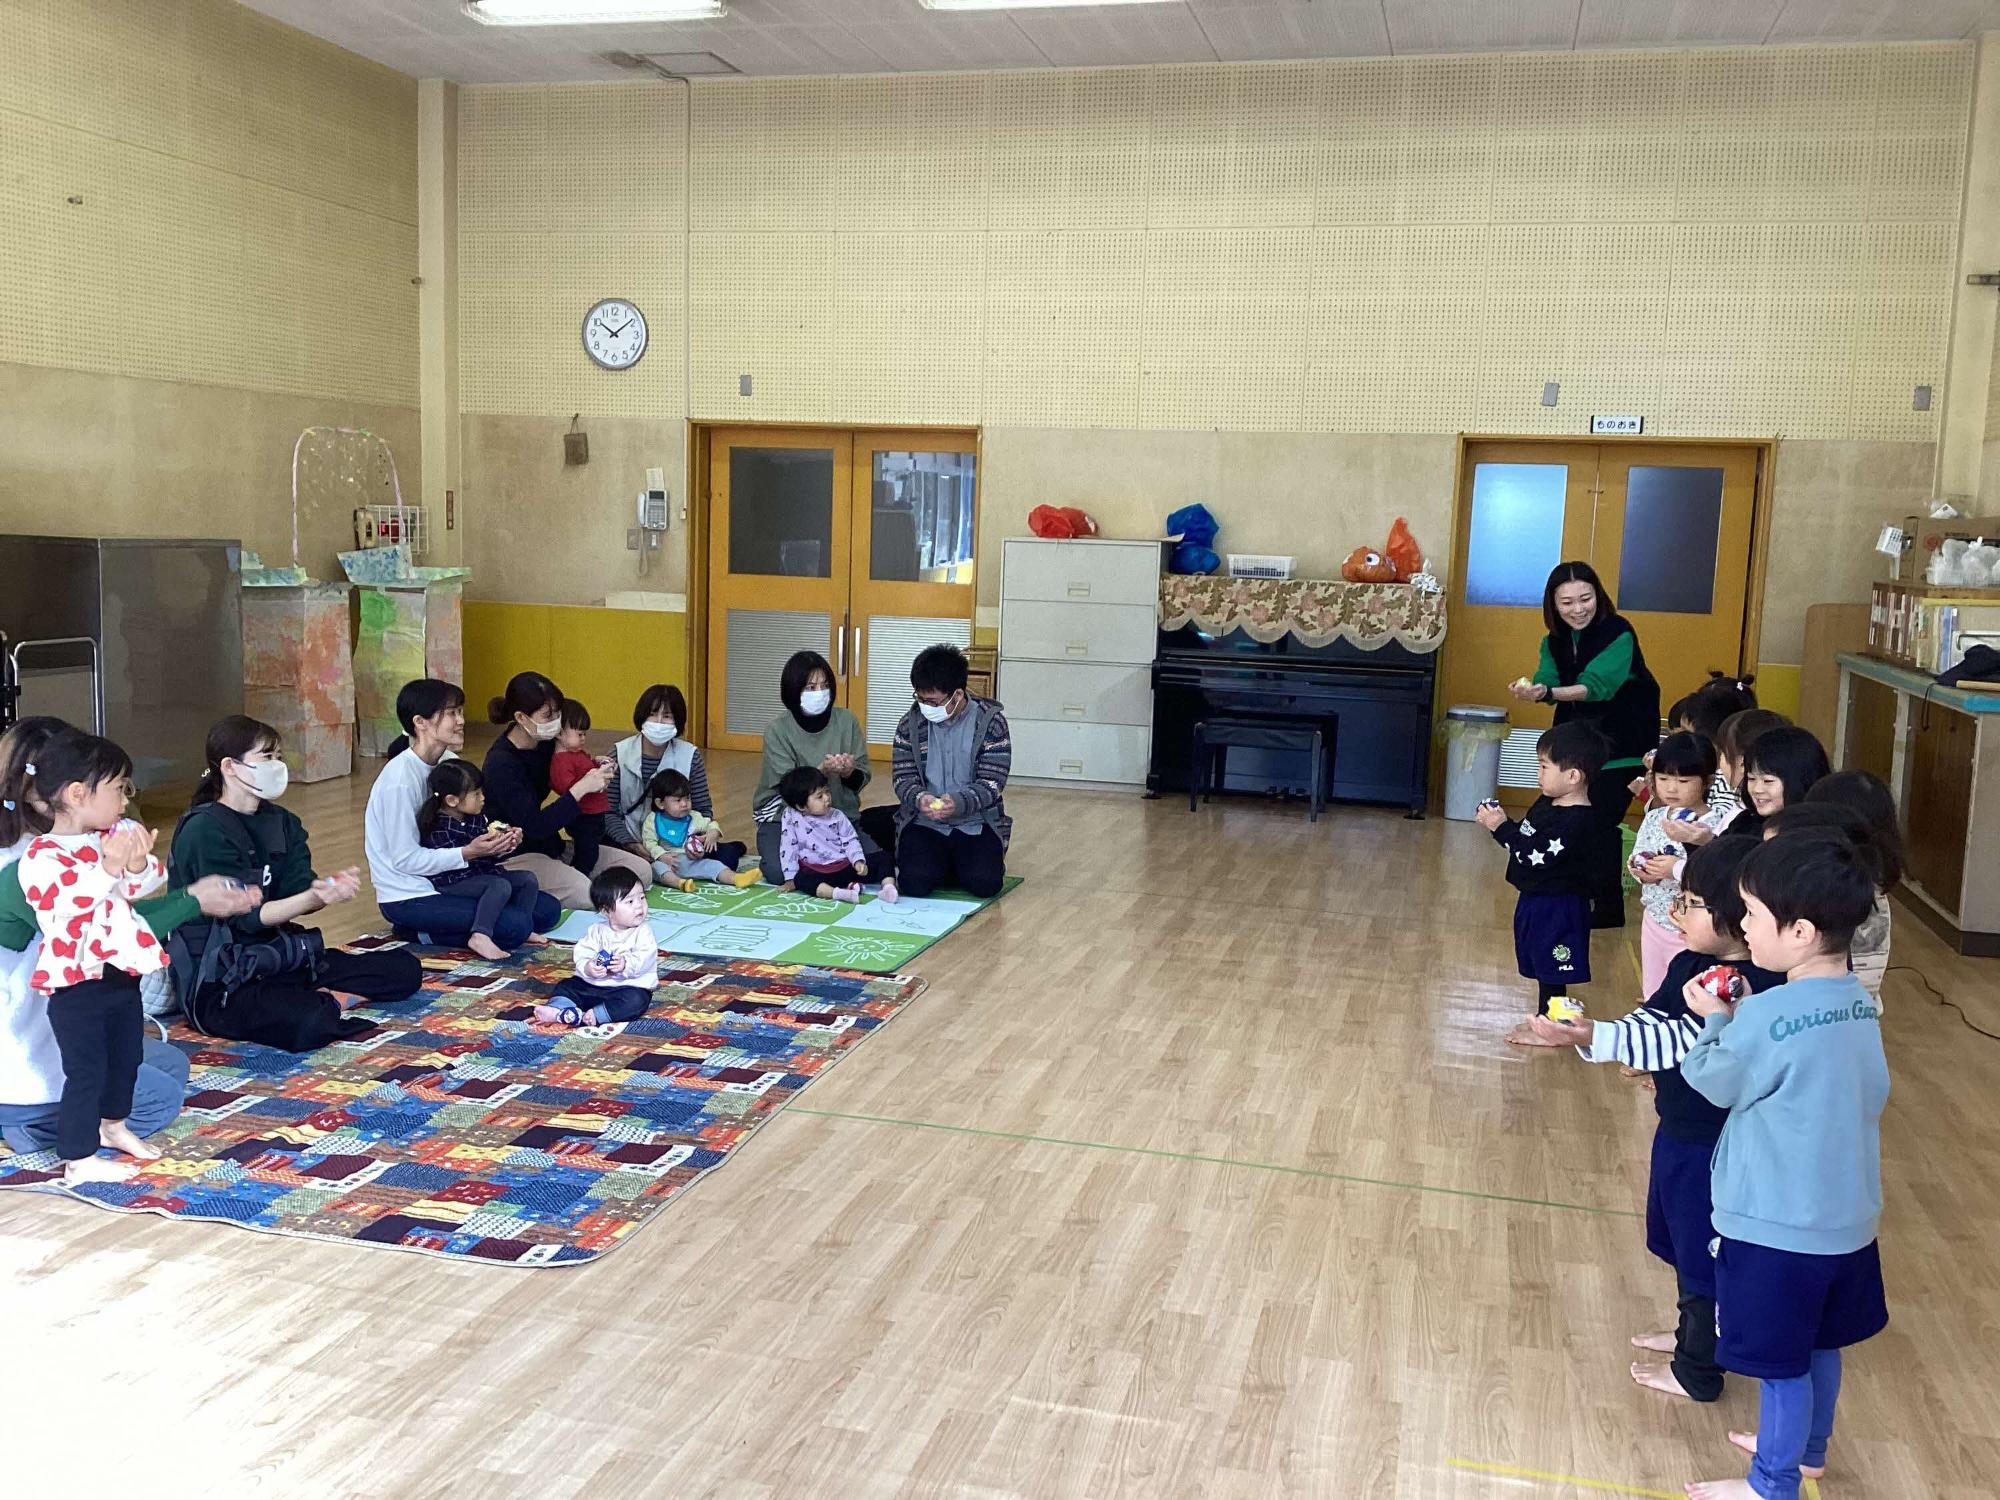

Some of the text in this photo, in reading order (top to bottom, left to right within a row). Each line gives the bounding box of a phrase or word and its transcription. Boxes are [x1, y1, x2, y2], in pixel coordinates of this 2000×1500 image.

[602, 309, 609, 318] 11
[611, 306, 619, 316] 12
[593, 317, 601, 327] 10
[630, 318, 636, 328] 2
[590, 328, 597, 338] 9
[633, 330, 640, 340] 3
[593, 341, 600, 351] 8
[630, 342, 636, 352] 4
[603, 349, 608, 359] 7
[611, 353, 618, 363] 6
[622, 350, 629, 360] 5
[1597, 420, 1637, 430] ものおき
[1769, 1007, 1850, 1042] Curious
